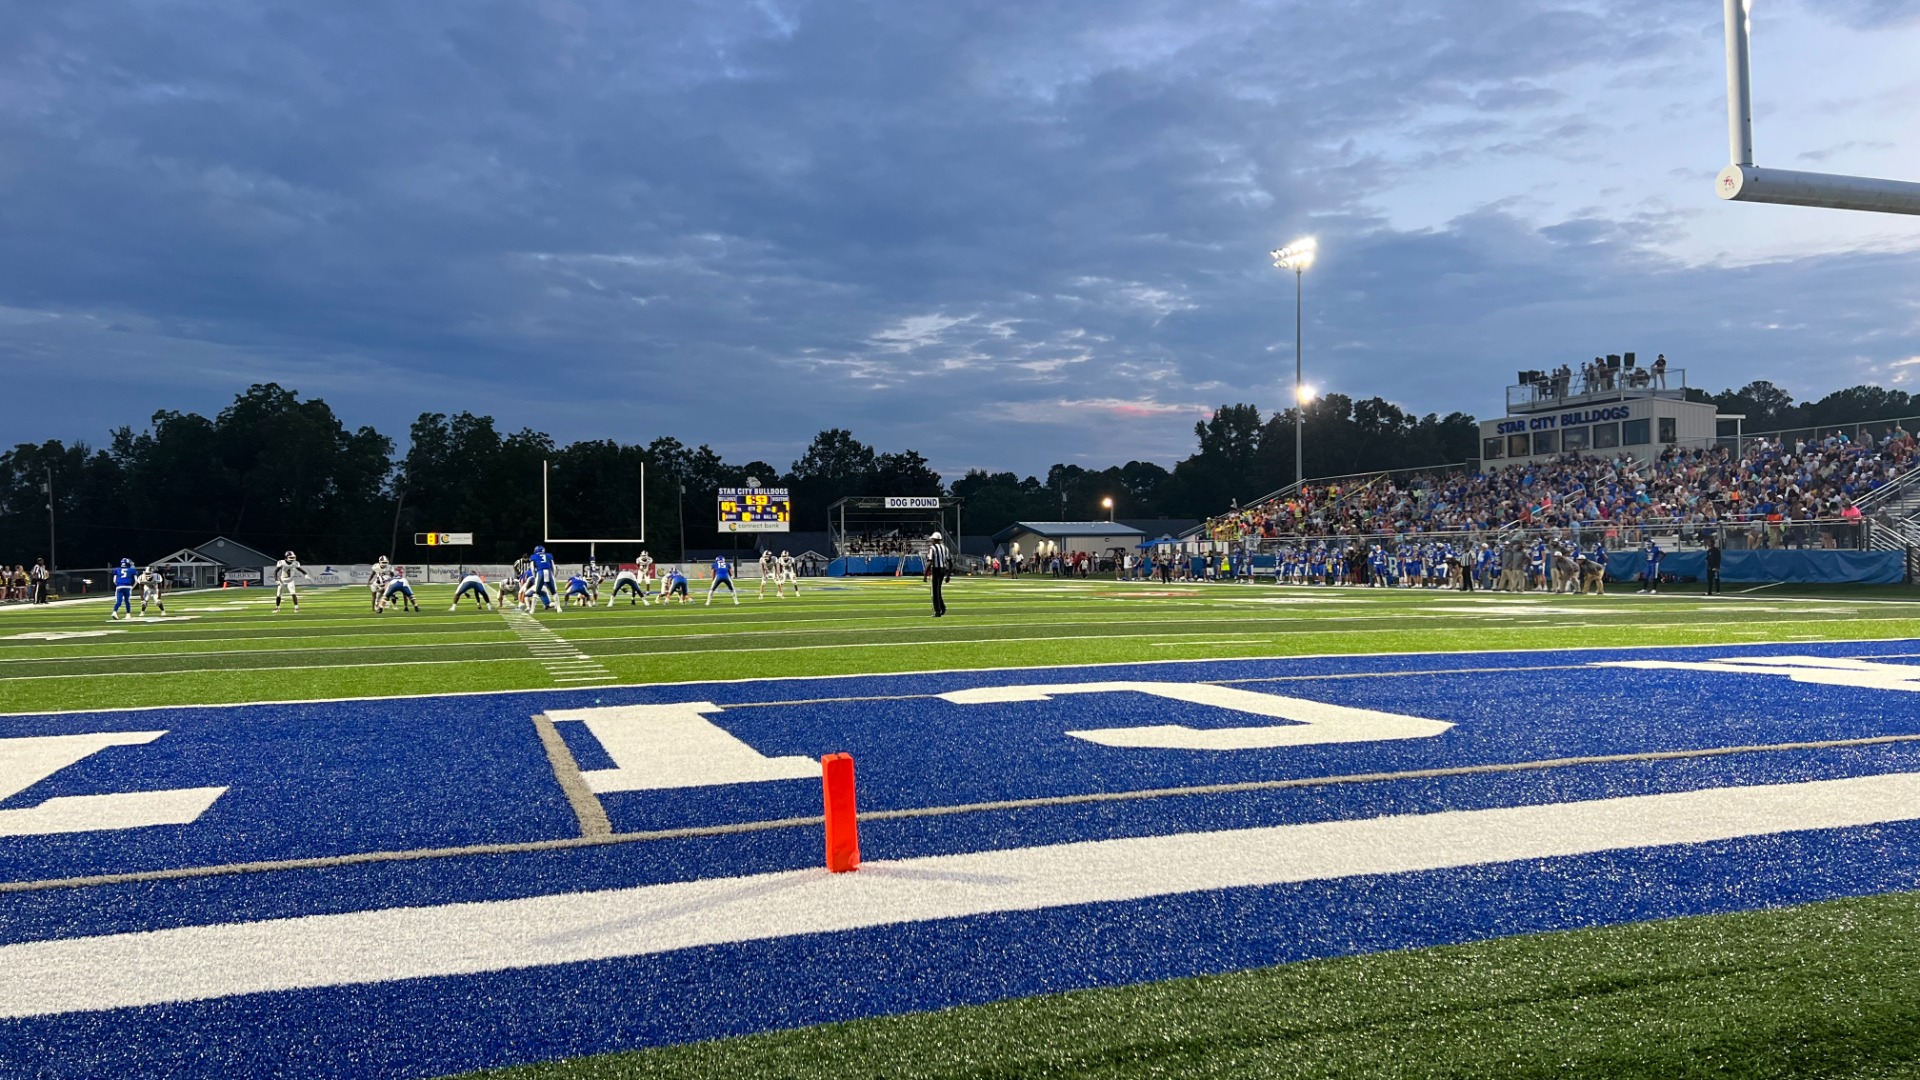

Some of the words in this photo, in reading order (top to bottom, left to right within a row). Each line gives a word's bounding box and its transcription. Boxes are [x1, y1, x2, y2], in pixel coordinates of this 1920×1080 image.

[1497, 420, 1526, 434] STAR
[1530, 415, 1557, 430] CITY
[1561, 406, 1630, 426] BULLDOGS
[746, 495, 768, 504] 6:53
[890, 498, 908, 506] DOG
[910, 498, 938, 506] POUND
[540, 554, 547, 563] 3
[120, 568, 128, 578] 5
